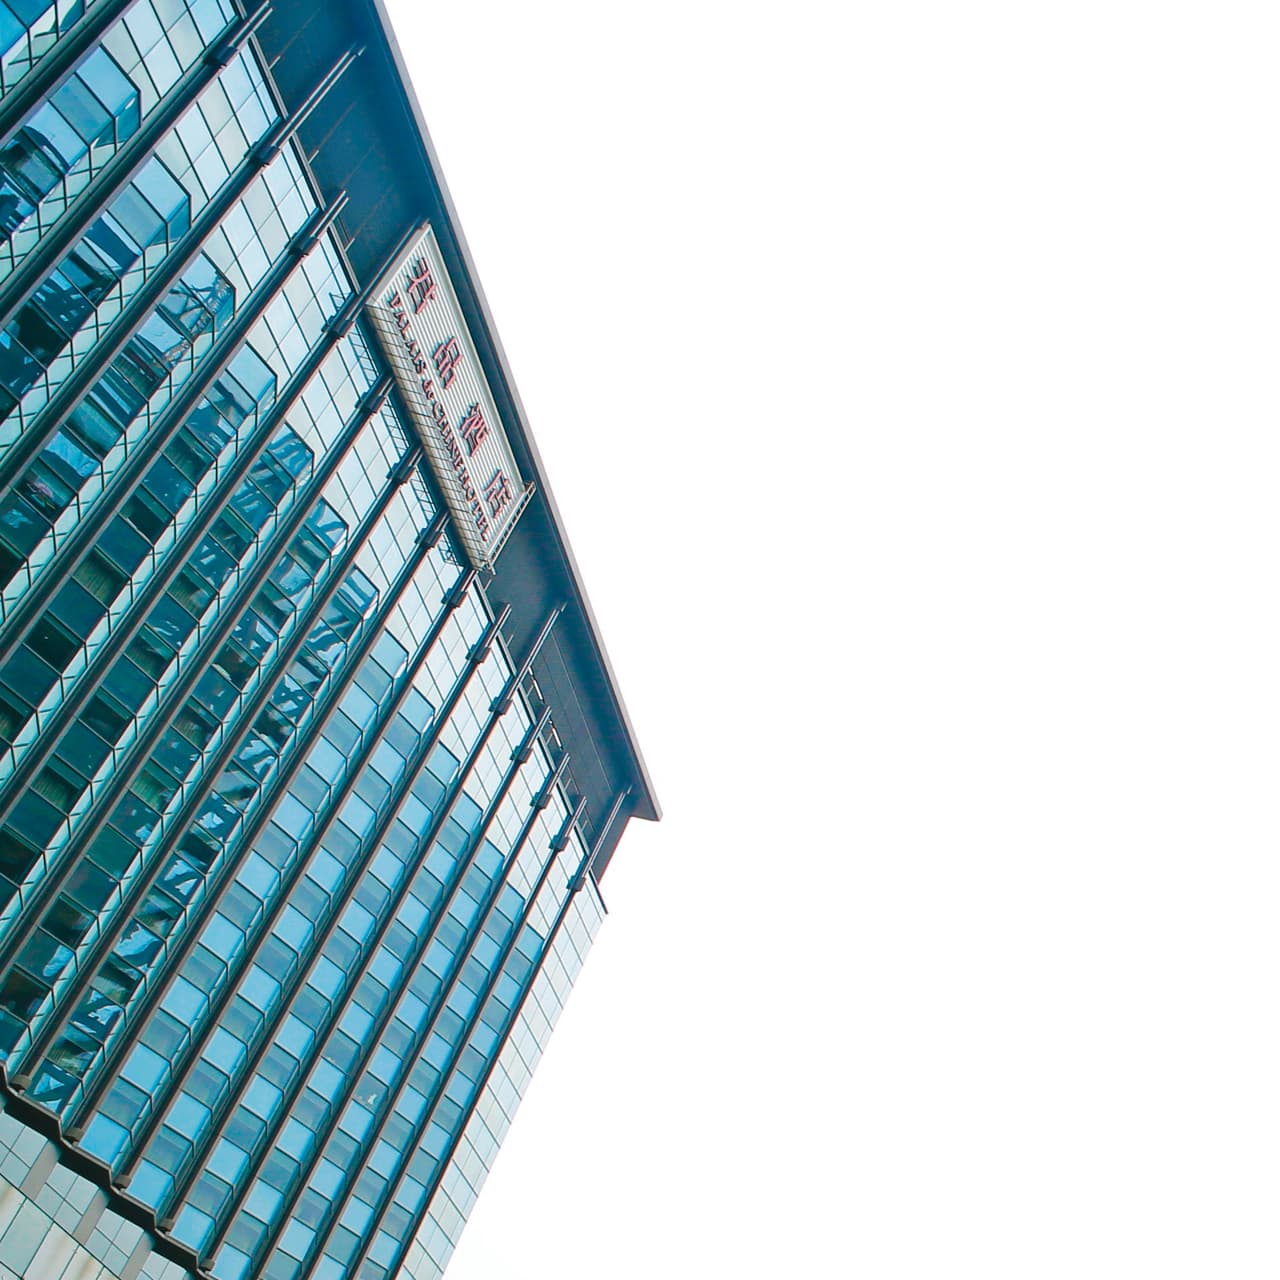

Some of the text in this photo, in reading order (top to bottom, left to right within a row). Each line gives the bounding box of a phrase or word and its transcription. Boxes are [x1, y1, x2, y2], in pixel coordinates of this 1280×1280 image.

[389, 290, 427, 375] PALAIS
[431, 401, 464, 470] CHINE
[459, 470, 489, 542] HOTEL
[407, 257, 512, 518] 君品酒店
